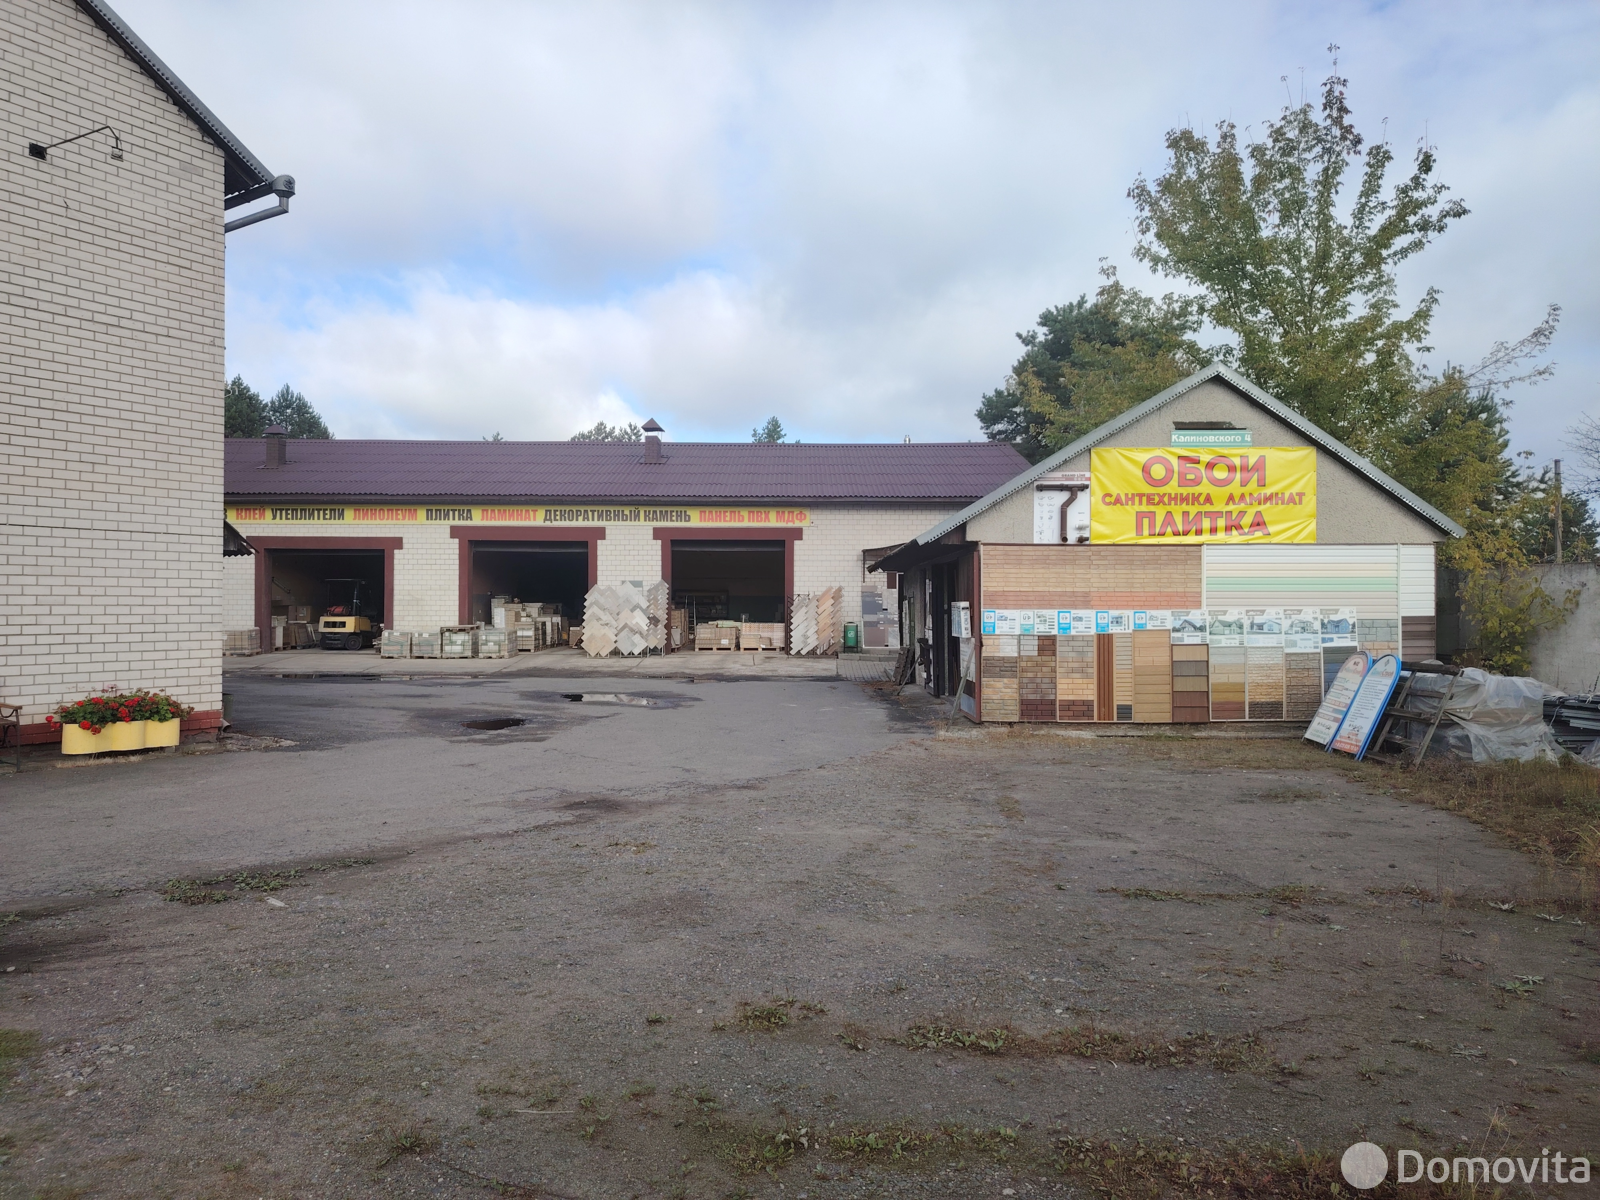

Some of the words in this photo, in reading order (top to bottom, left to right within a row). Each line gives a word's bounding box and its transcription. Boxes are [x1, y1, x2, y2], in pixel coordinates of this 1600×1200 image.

[1171, 434, 1242, 443] Калиновского
[1244, 433, 1252, 442] 4
[1142, 454, 1267, 488] ОБОИ
[1101, 492, 1214, 506] САНТЕХНИКА
[1225, 492, 1306, 506] ЛАМИНАТ
[235, 505, 266, 521] КЛЕЙ
[271, 507, 345, 521] УТЕПЛИТЕЛИ
[352, 507, 418, 522] ЛИНОЛЕУМ
[425, 508, 473, 522] ПЛИТКА
[480, 508, 538, 522] ЛАМИНАТ
[543, 507, 641, 523] ДЕКОРАТИВНЫЙ
[643, 509, 691, 523] КАМЕНЬ
[699, 509, 745, 523] ПАНЕЛЬ
[747, 509, 771, 523] ПВХ
[775, 509, 807, 524] МДФ
[1135, 511, 1271, 537] ПЛИТКА
